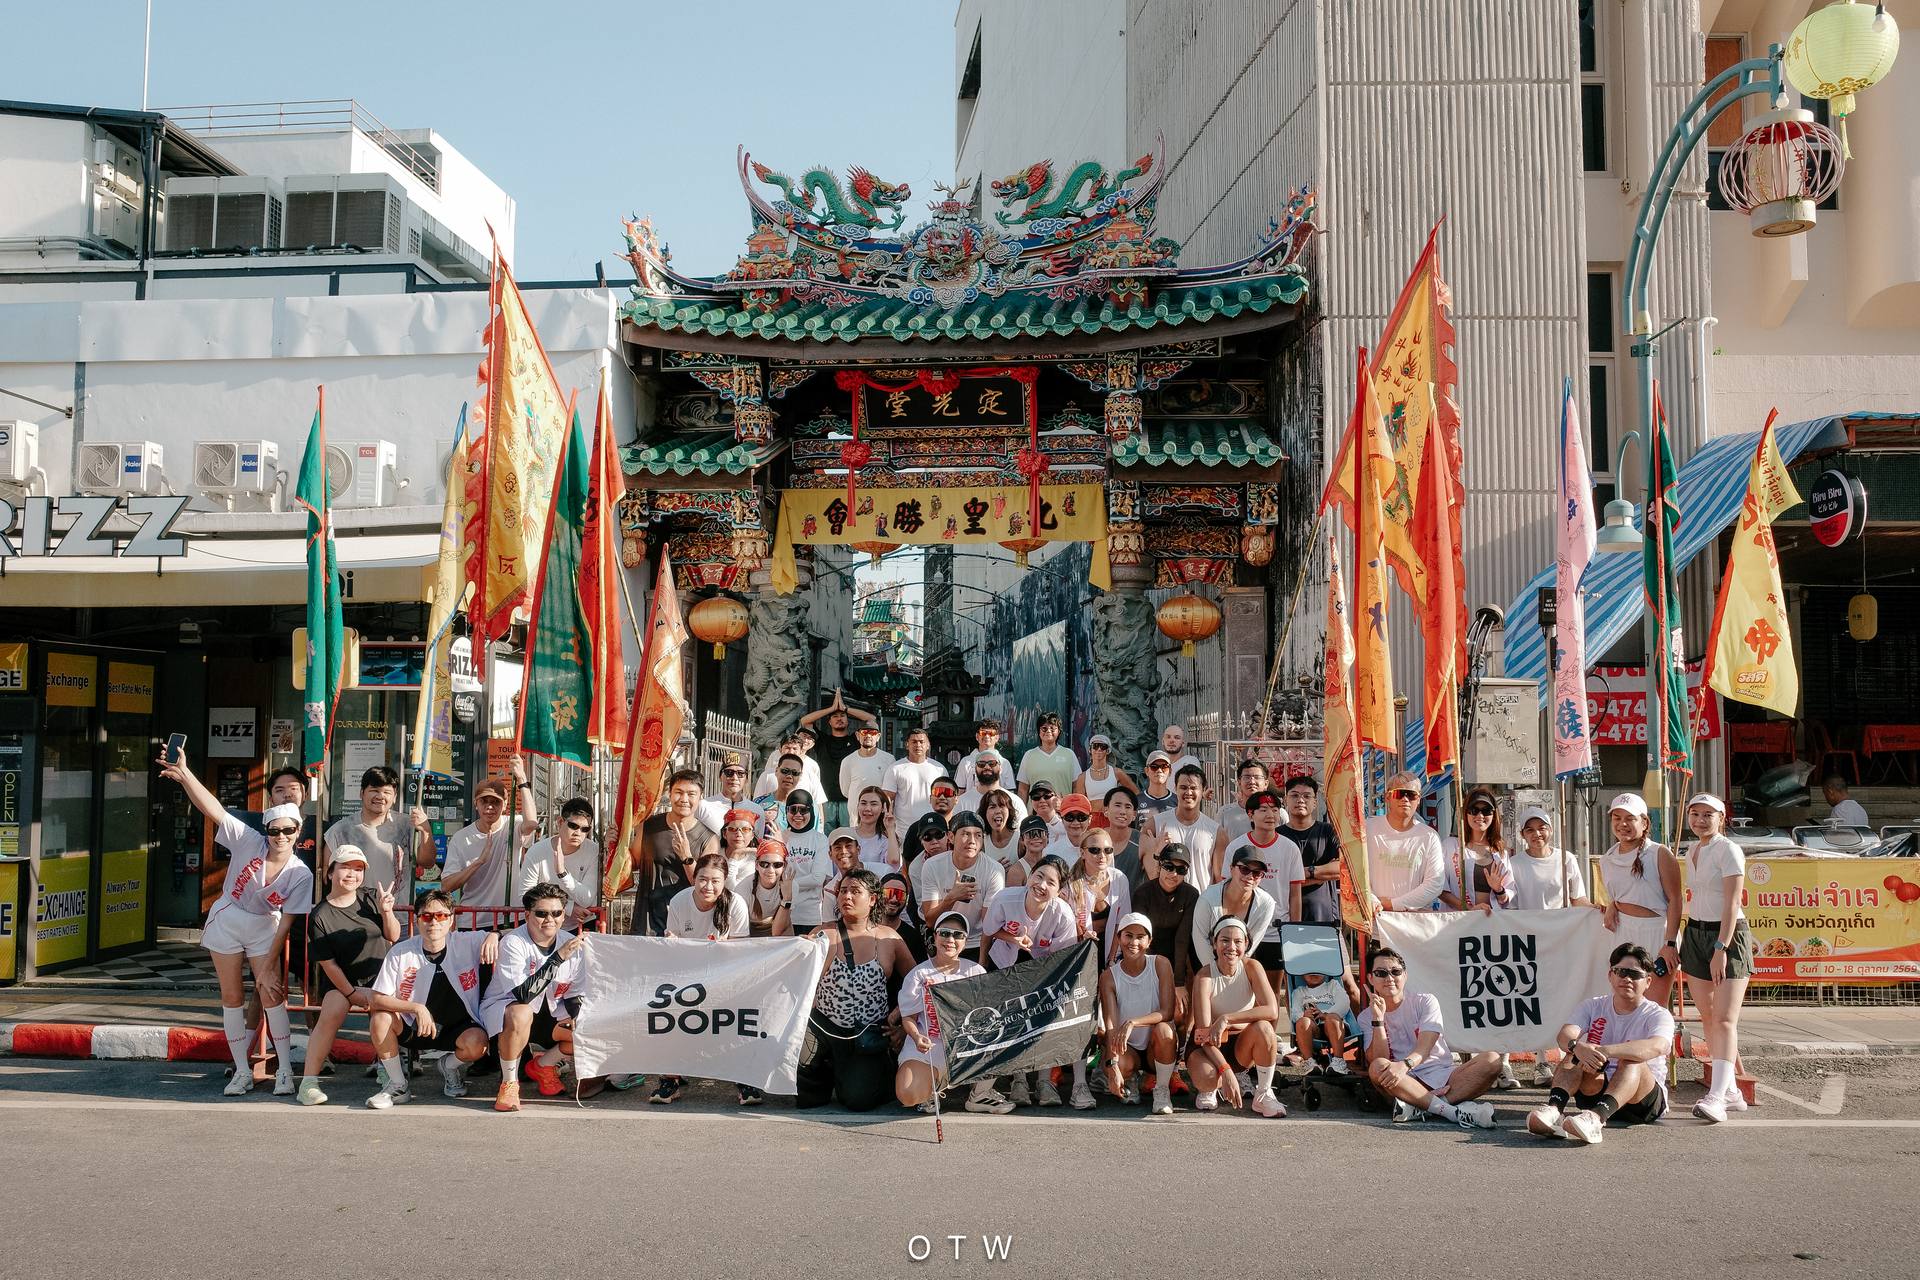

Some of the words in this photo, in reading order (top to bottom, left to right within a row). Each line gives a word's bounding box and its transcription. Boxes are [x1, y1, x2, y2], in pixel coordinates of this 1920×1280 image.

[242, 459, 258, 467] Haier
[46, 672, 89, 689] Exchange
[107, 682, 121, 694] Best
[121, 682, 134, 694] Rate
[134, 684, 142, 694] No
[142, 685, 152, 696] Fee
[211, 724, 253, 737] RIZZ
[335, 720, 353, 728] TOUR
[4, 772, 16, 822] OPEN
[106, 880, 127, 894] Always
[127, 879, 140, 891] Your
[37, 885, 87, 922] EXCHANGE
[106, 903, 119, 914] Best
[120, 901, 139, 912] Choice
[1785, 913, 1875, 932] จังหวัดภูเก็ต
[1458, 934, 1537, 964] RUN
[1800, 963, 1818, 973] วันที่
[1824, 965, 1834, 973] 10
[1844, 965, 1853, 973] 18
[1857, 965, 1889, 976] ตุลาคม
[1460, 961, 1538, 998] BOY
[647, 983, 707, 1009] SO
[1460, 997, 1542, 1029] RUN
[647, 1008, 768, 1039] DOPE.
